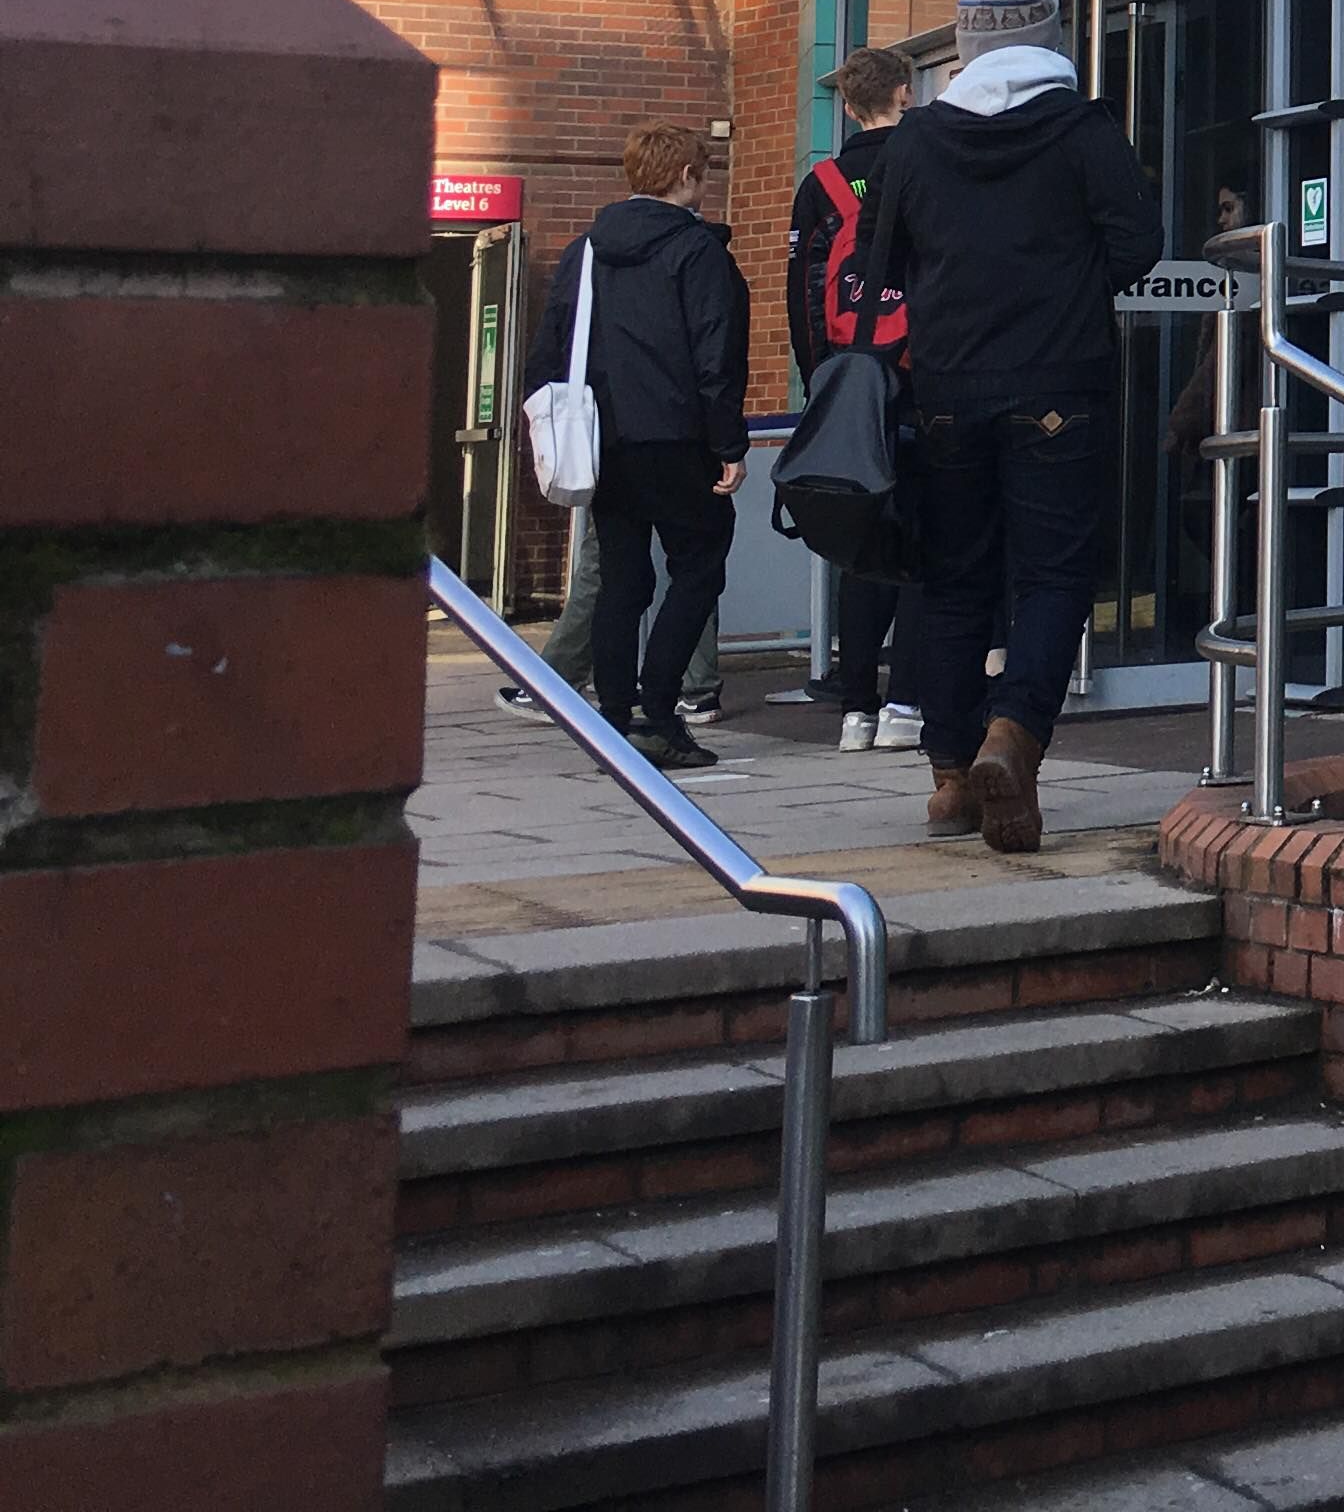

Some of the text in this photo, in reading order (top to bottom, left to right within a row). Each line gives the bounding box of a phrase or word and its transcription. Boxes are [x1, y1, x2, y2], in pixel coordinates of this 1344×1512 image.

[432, 178, 502, 194] Theatres
[433, 196, 489, 212] Level 6
